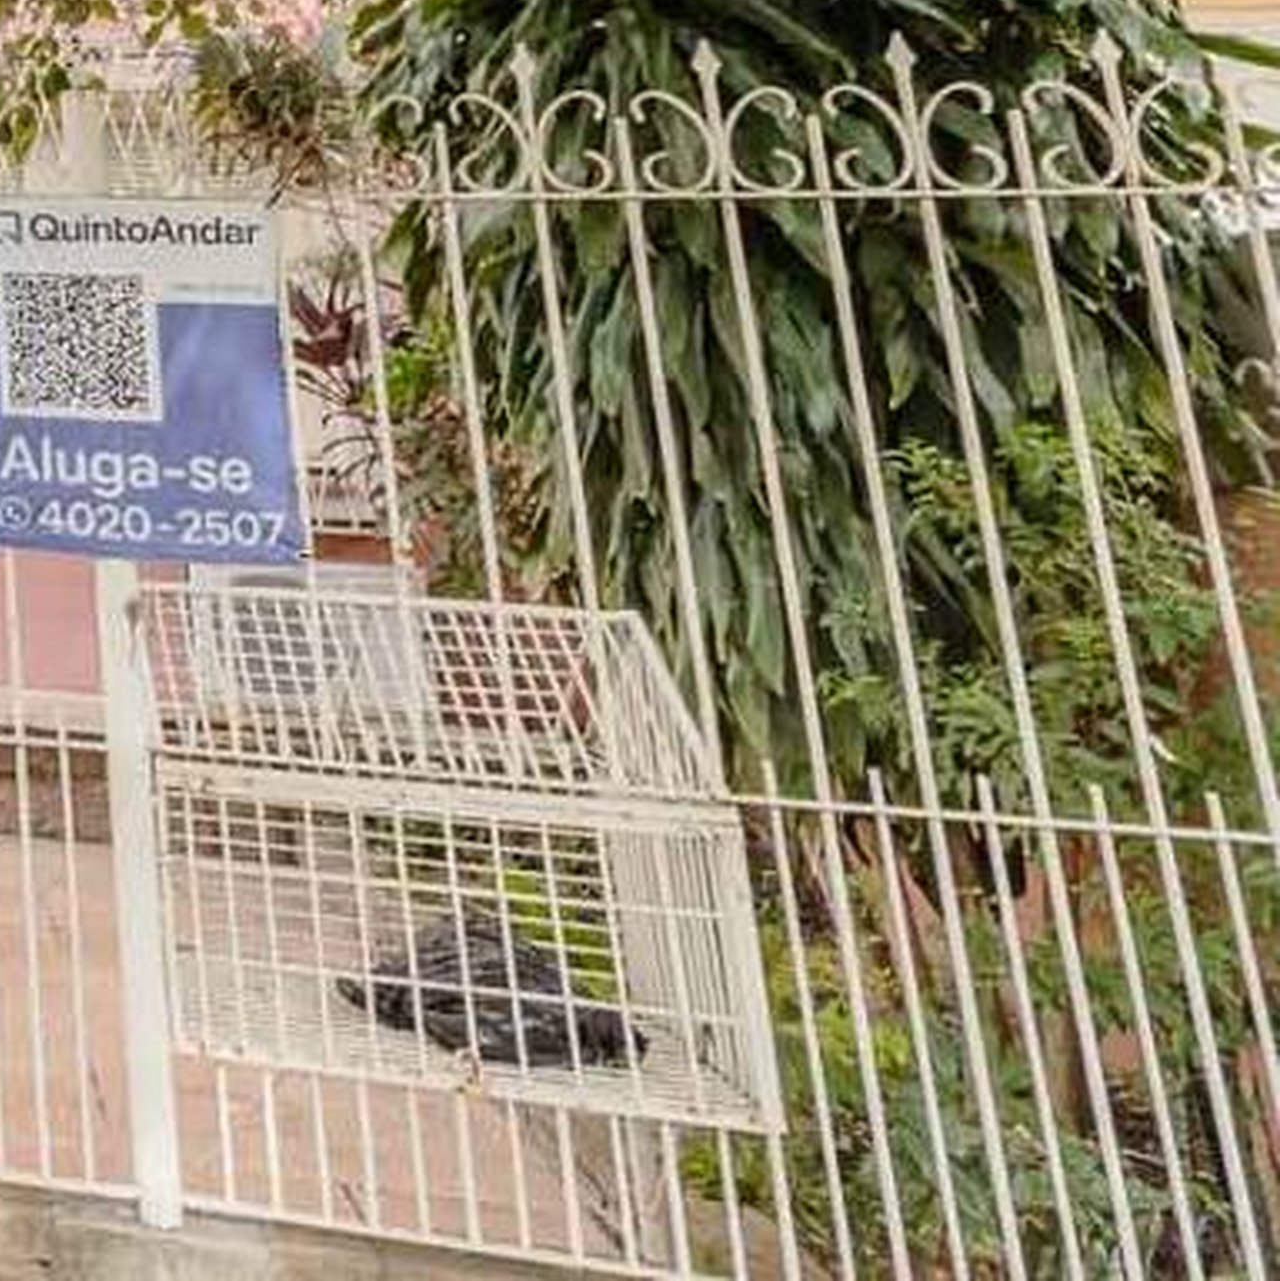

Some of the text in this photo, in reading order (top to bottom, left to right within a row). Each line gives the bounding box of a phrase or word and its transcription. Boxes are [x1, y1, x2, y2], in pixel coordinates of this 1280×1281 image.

[29, 213, 262, 246] QuintoAndar
[0, 433, 253, 499] Aluga-se
[37, 499, 285, 547] 4020-2507
